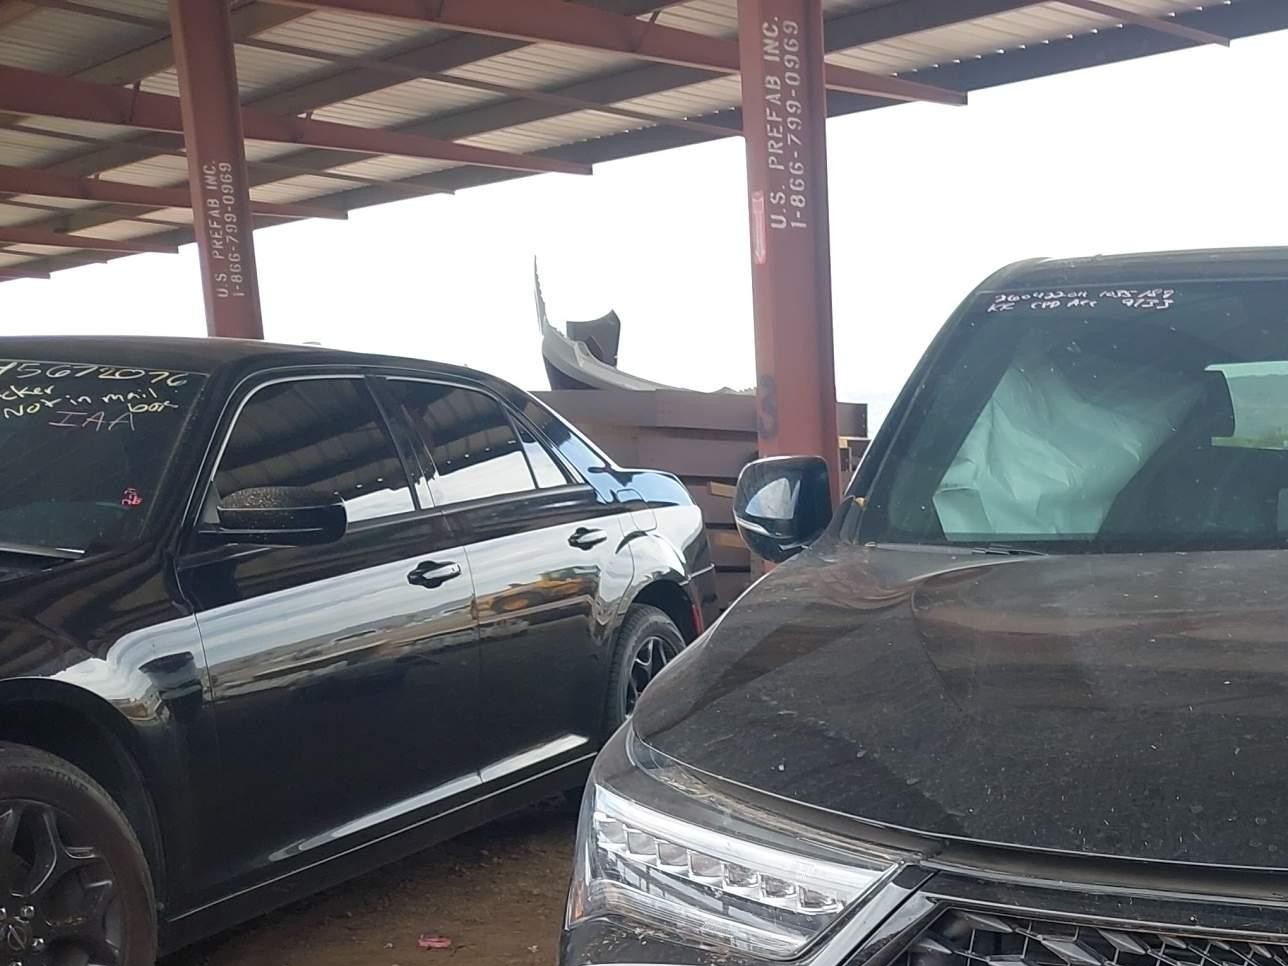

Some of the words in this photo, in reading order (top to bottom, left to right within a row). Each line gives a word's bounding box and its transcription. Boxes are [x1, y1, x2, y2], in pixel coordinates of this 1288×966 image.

[762, 16, 780, 62] INC.
[765, 76, 785, 170] PREFAB
[783, 20, 808, 229] 1-866-799-0969
[203, 160, 218, 190] INC.
[207, 198, 225, 259] PREFAB
[218, 162, 246, 297] 1-866-799-0969
[770, 185, 787, 229] U.S.
[48, 411, 135, 431] IAA
